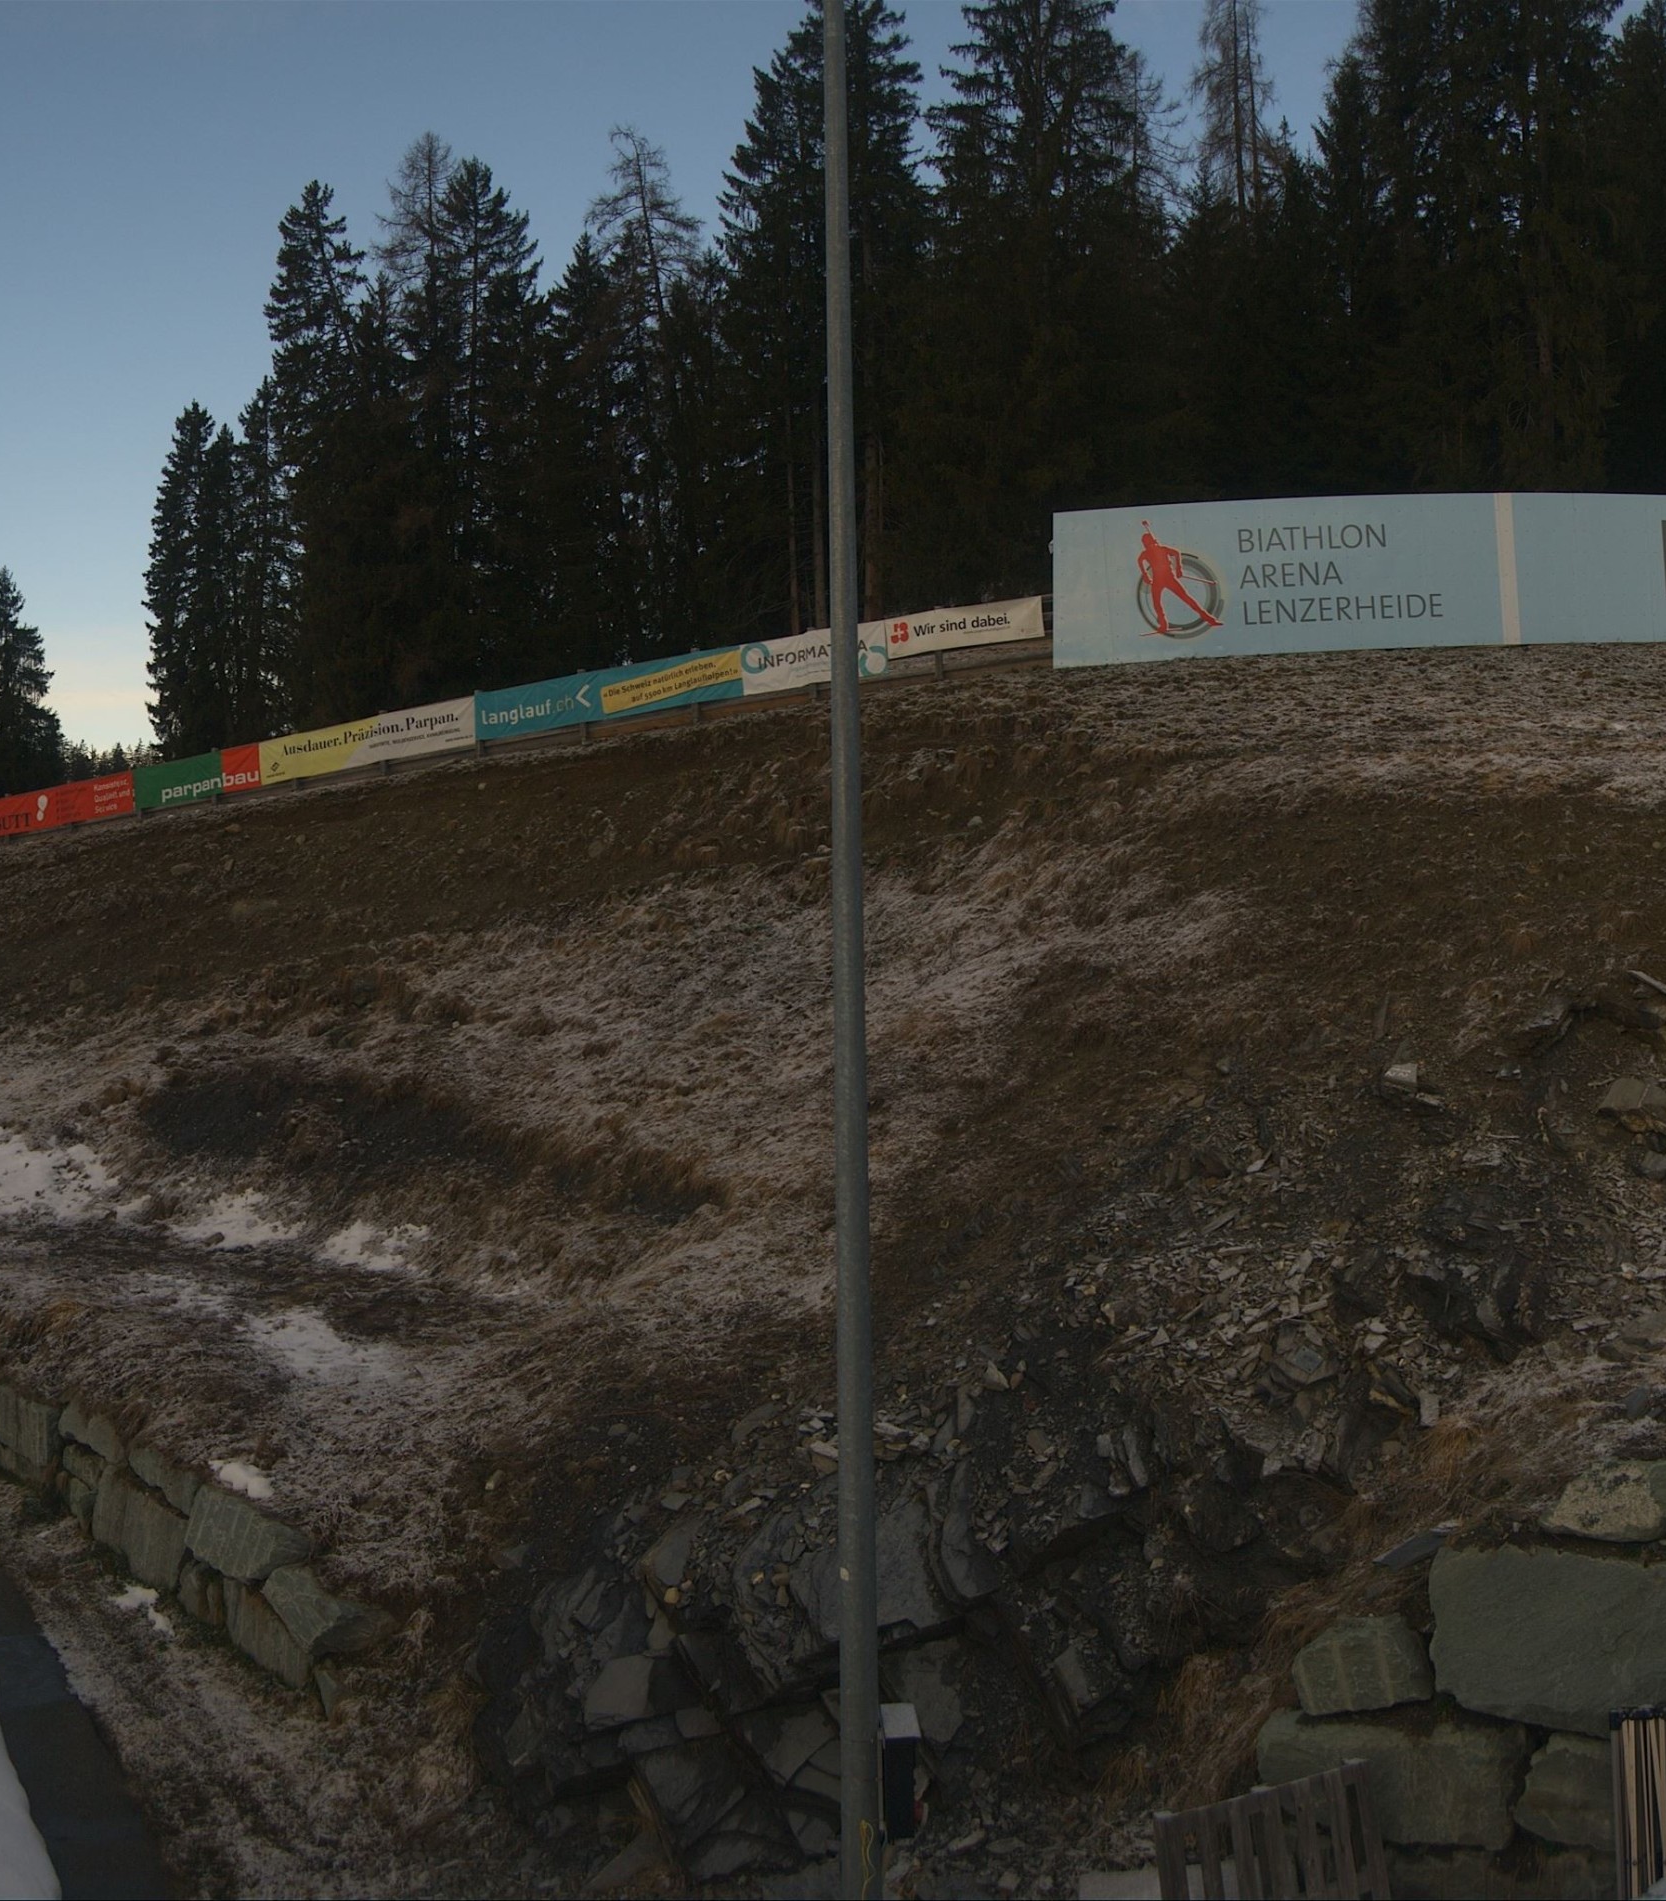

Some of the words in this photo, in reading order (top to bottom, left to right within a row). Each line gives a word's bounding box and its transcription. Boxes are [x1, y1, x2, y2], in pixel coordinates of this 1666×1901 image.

[1237, 523, 1387, 553] BIATHLON
[1239, 561, 1344, 590] ARENA
[913, 624, 937, 637] Wir
[939, 617, 967, 634] sind
[970, 612, 1011, 629] dabei.
[1243, 593, 1444, 626] LENZERHEIDE
[481, 695, 575, 727] langlauf.ch
[343, 721, 405, 745] Präzision.
[405, 711, 460, 732] Parpan.
[160, 770, 259, 803] parpanbau
